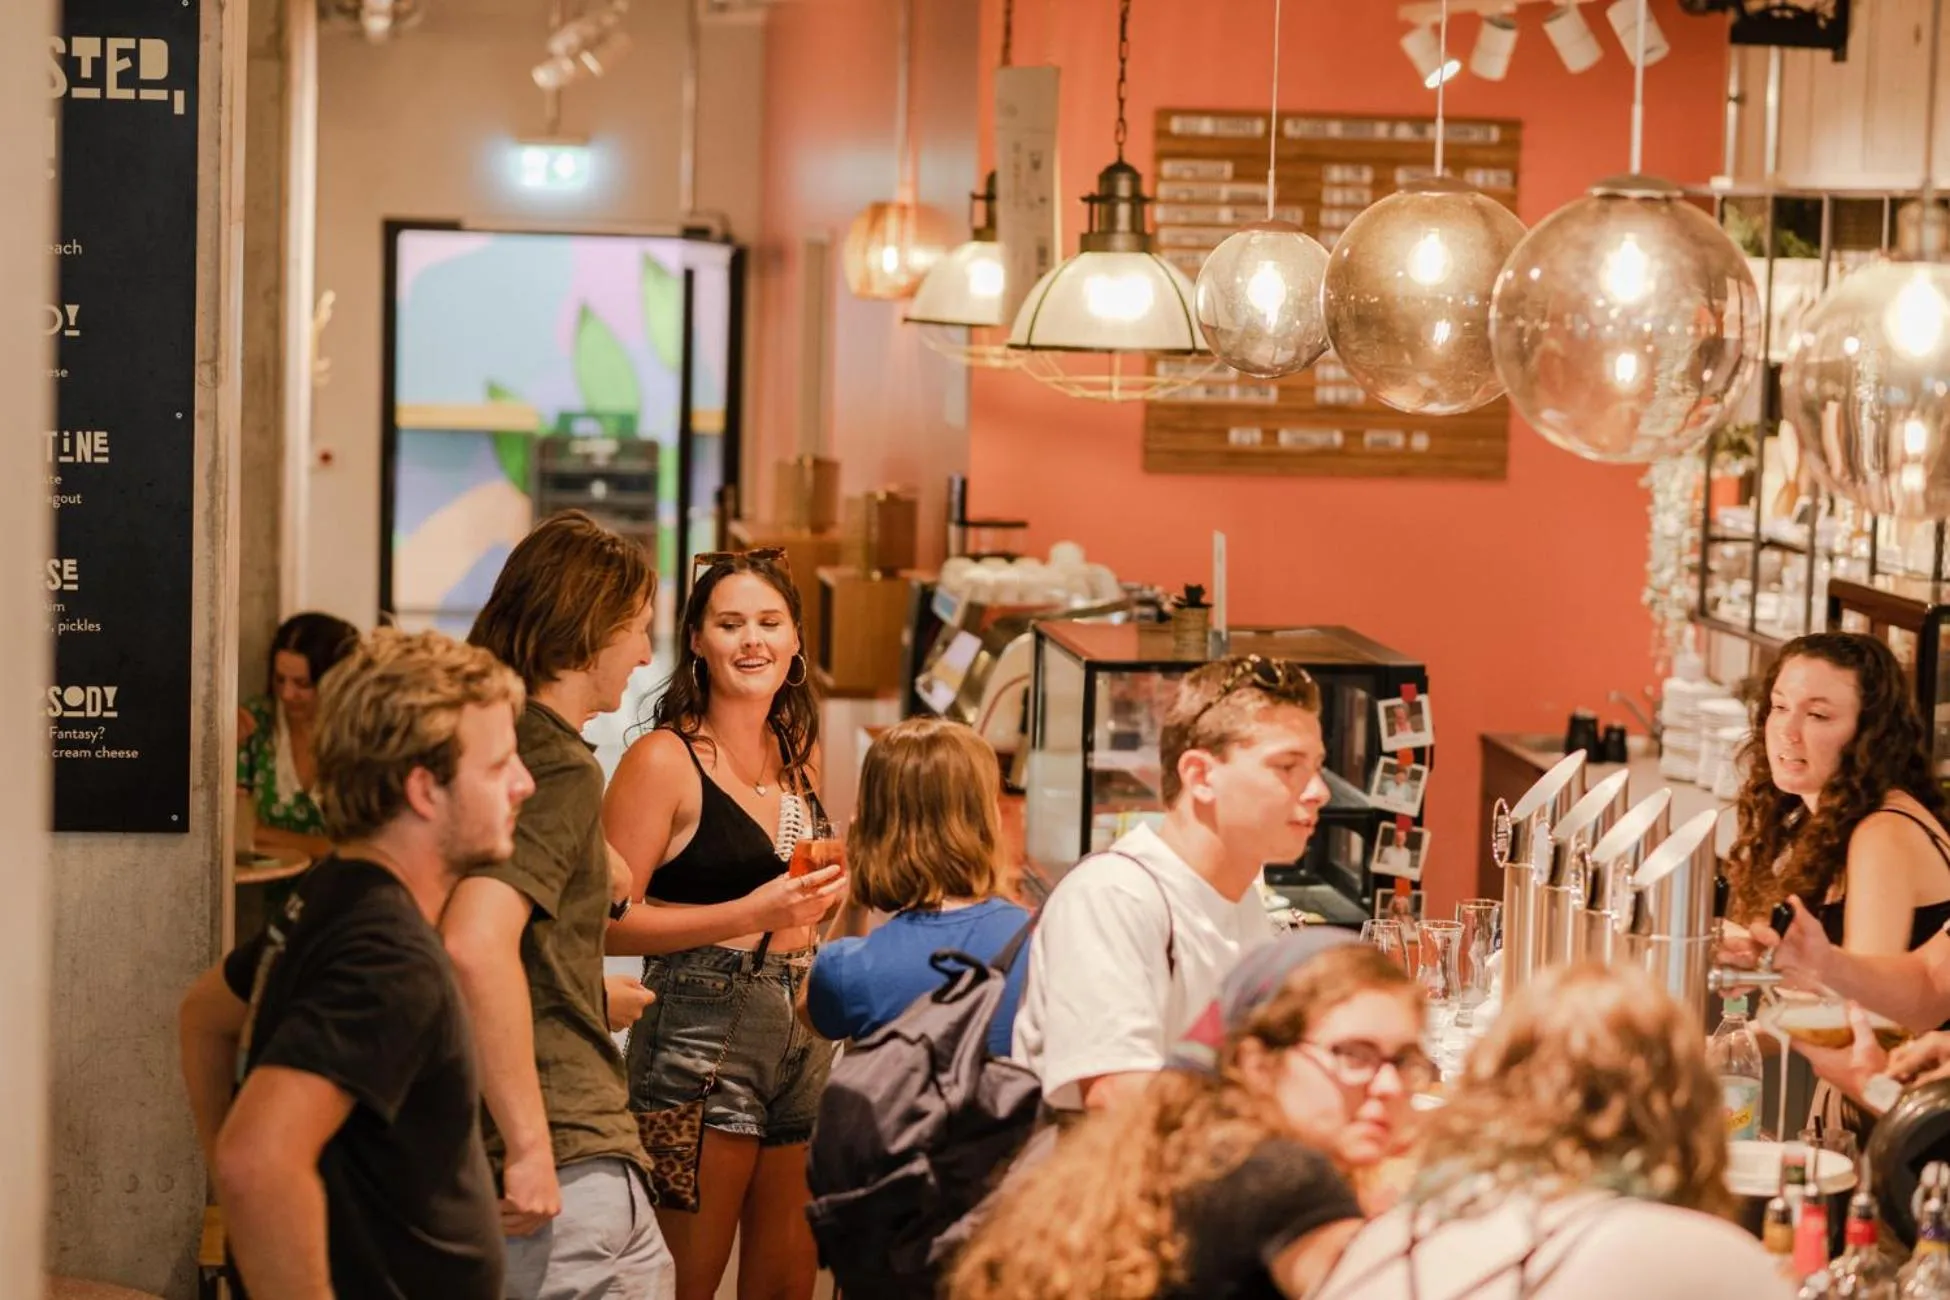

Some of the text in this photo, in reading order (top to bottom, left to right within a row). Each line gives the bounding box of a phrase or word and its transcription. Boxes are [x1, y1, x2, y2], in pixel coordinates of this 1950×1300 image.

[58, 618, 101, 636] pickles
[49, 726, 106, 744] Fantasy?
[52, 748, 91, 759] cream
[95, 745, 139, 759] cheese
